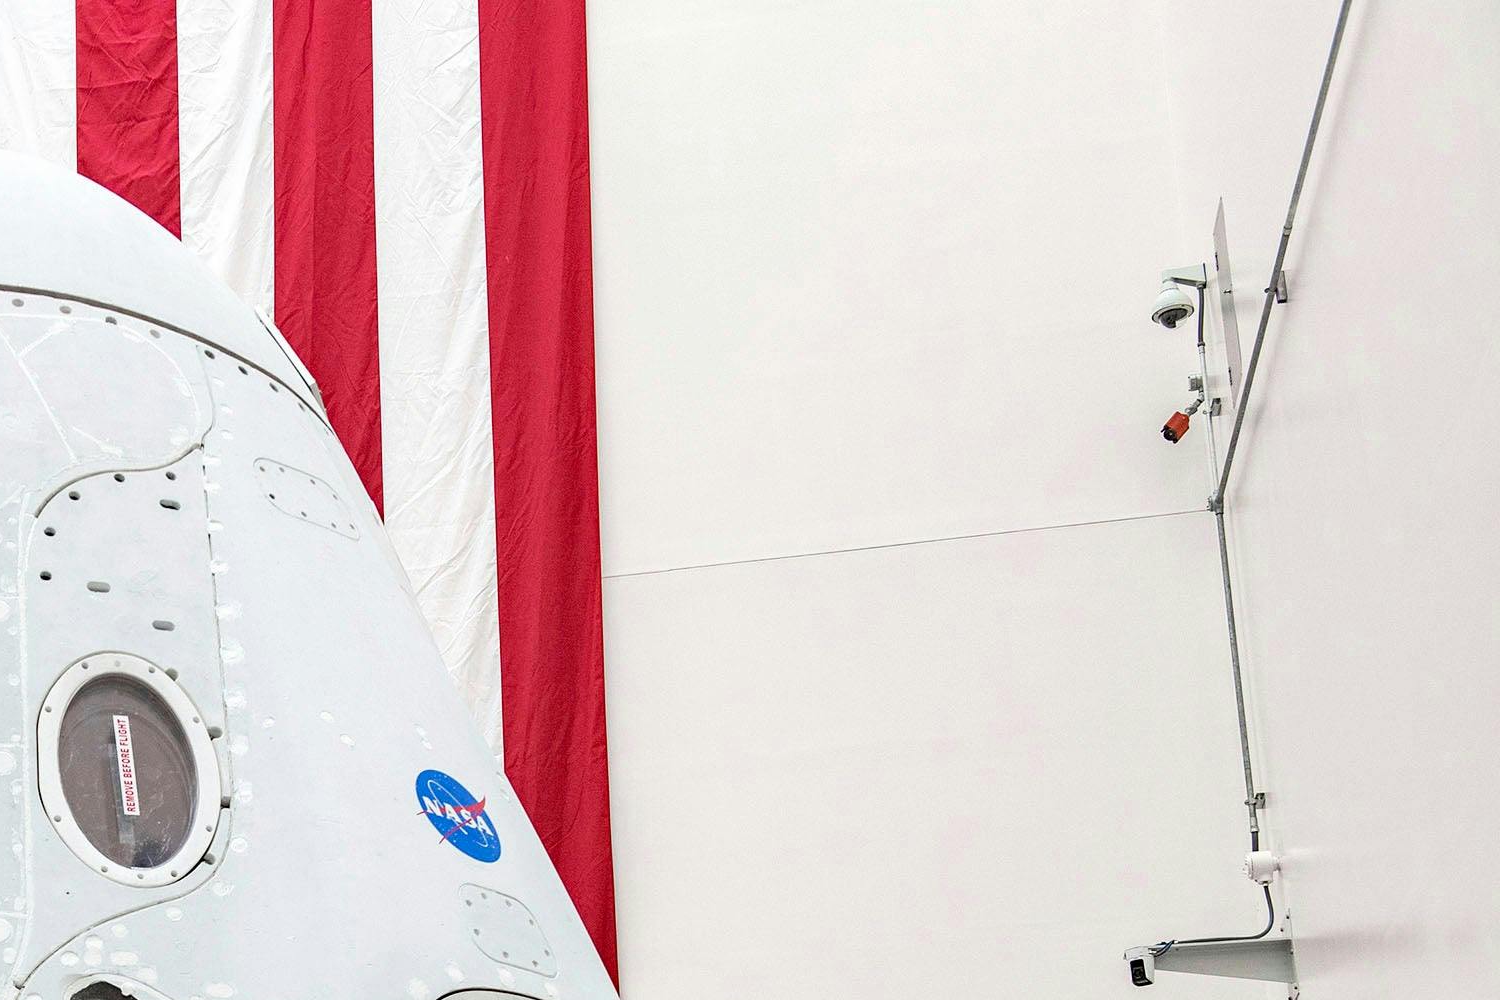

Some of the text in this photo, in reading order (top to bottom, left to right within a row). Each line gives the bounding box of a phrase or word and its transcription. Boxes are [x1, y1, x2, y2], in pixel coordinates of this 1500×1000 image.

[117, 719, 136, 812] REMOVE BEFORE FLIGHT
[422, 796, 494, 836] NASA
